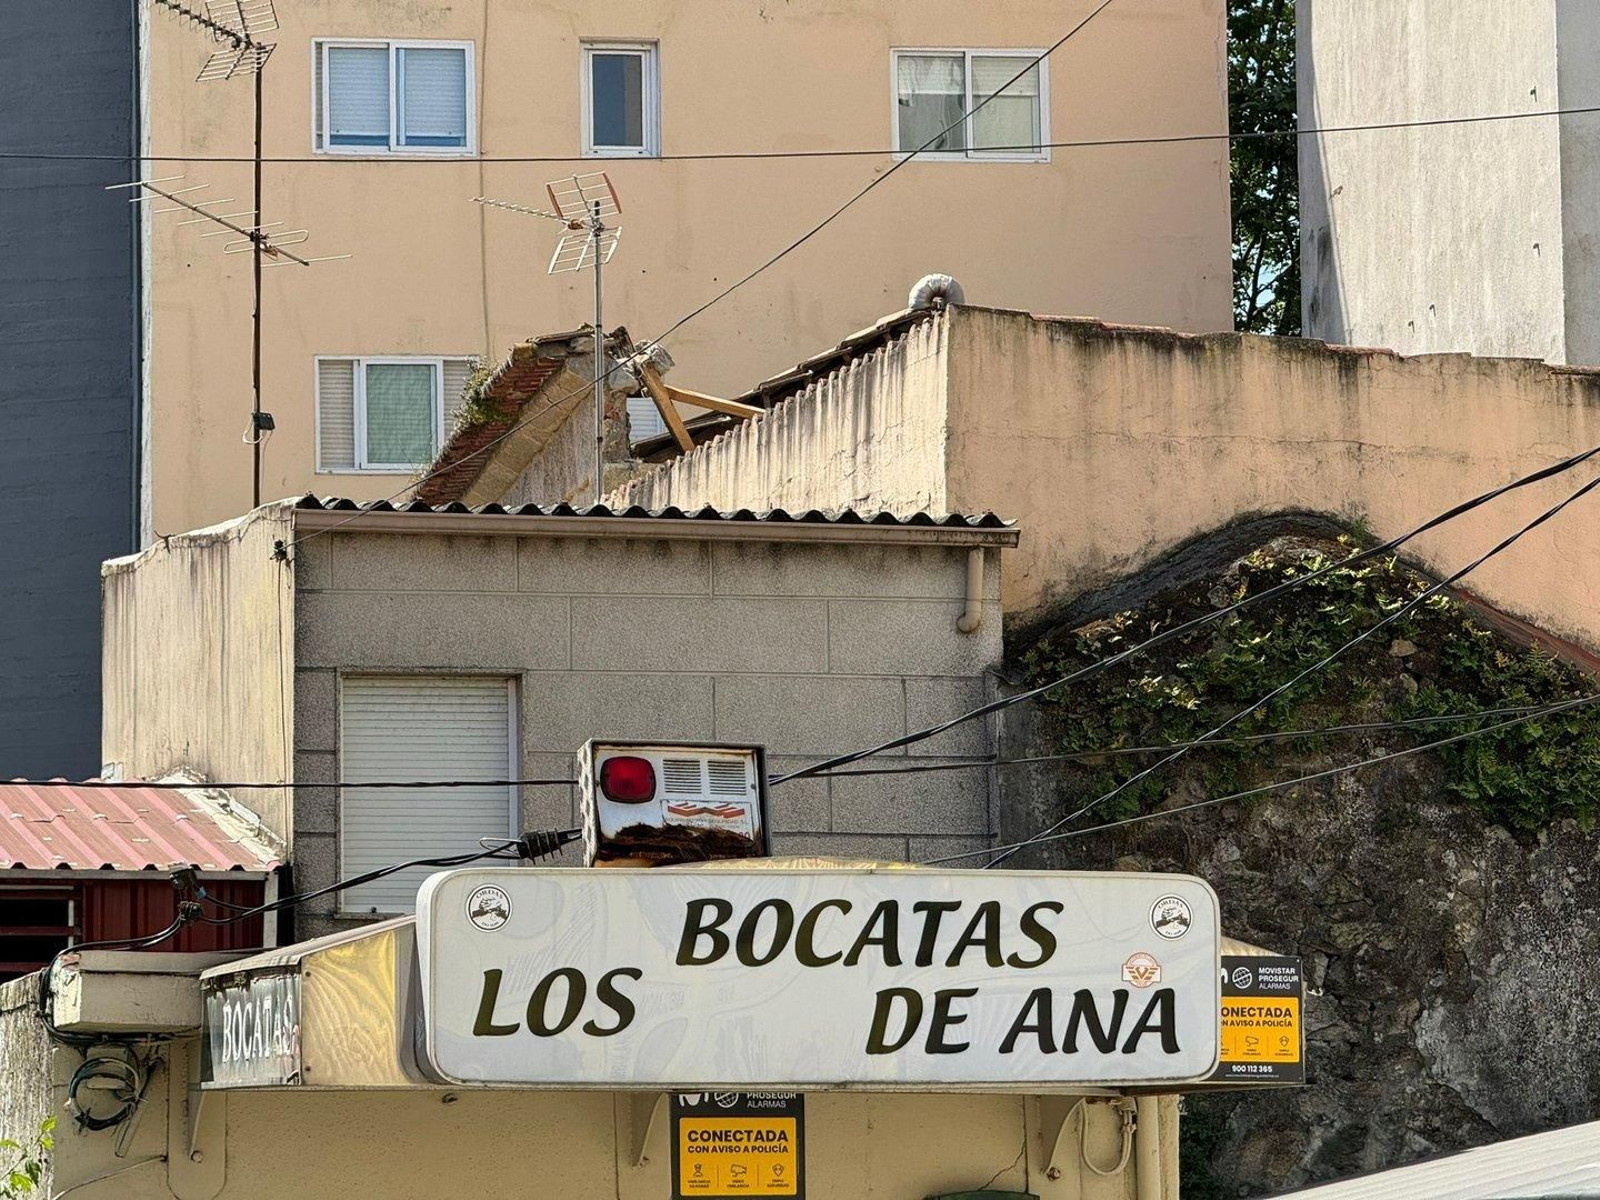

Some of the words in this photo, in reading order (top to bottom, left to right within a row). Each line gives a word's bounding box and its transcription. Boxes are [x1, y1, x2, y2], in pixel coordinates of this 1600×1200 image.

[676, 898, 1064, 968] BOCATAS
[1258, 967, 1296, 975] MOVISTAR
[1258, 975, 1299, 983] PROSEGUR
[473, 968, 642, 1037] LOS
[1221, 1006, 1293, 1018] ONECTADA
[866, 988, 978, 1054] DE
[999, 989, 1180, 1054] ANA
[1229, 1019, 1254, 1027] AVISO
[1262, 1018, 1293, 1027] POLICÍA
[1231, 1065, 1246, 1073] 900
[1247, 1065, 1257, 1073] 112
[746, 1100, 787, 1108] ALARMAS
[687, 1130, 789, 1142] CONECTADA
[687, 1145, 709, 1153] CON
[711, 1145, 741, 1153] AVISO
[751, 1143, 789, 1153] POLICÍA
